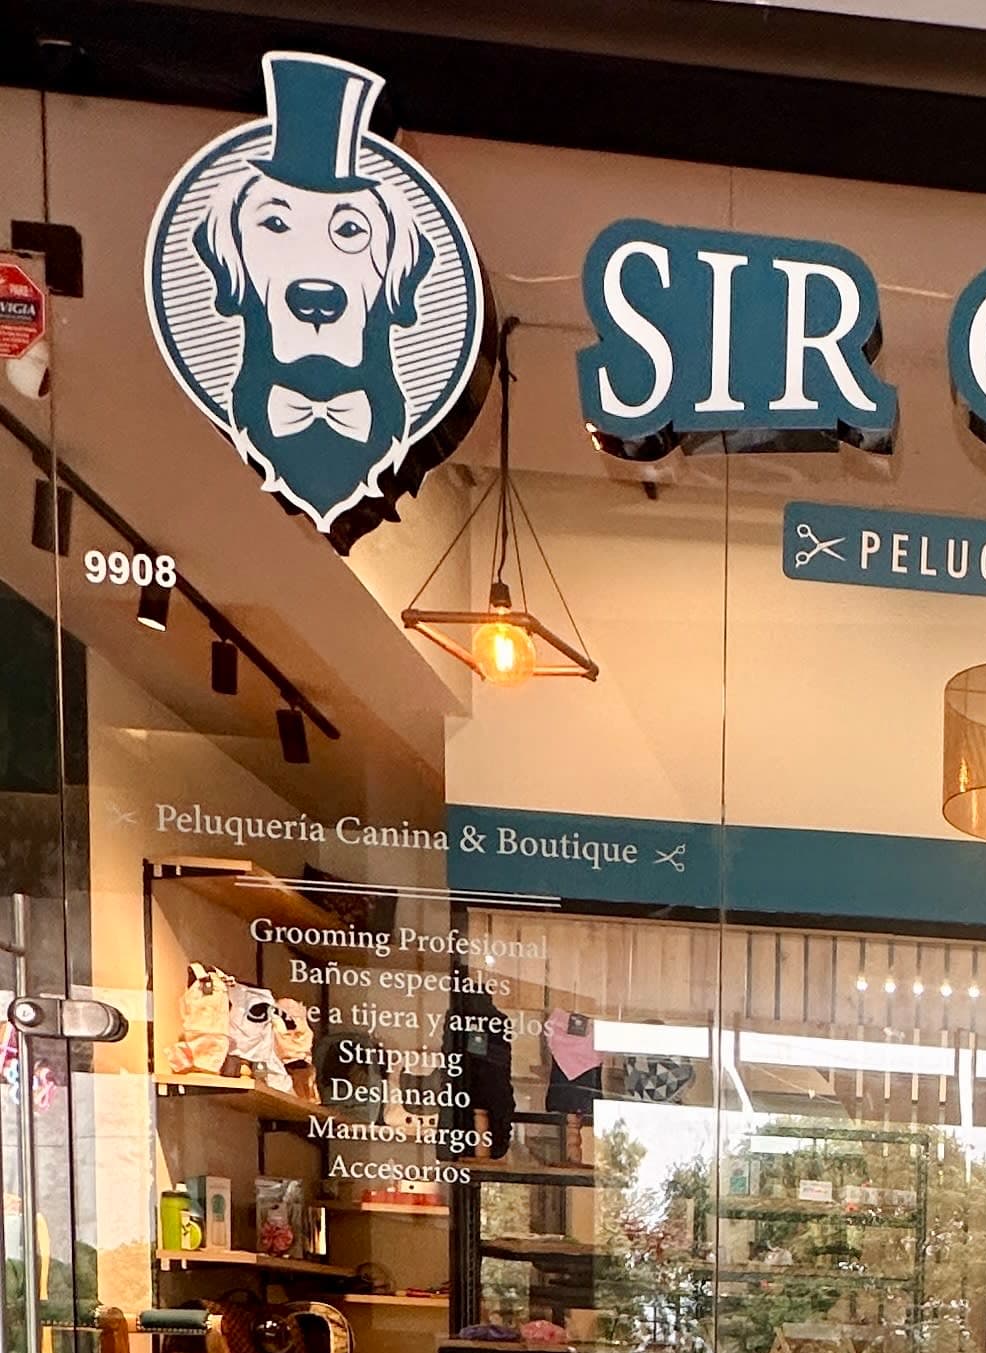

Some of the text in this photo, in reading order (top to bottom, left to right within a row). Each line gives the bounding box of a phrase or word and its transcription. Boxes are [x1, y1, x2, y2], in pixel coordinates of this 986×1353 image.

[598, 240, 878, 419] SIR
[84, 551, 177, 588] 9908
[155, 803, 639, 871] Peluquería Canina & Boutique
[250, 917, 549, 960] Grooming Profesional
[289, 959, 512, 997] Baños especiales
[328, 1007, 343, 1024] a
[351, 1004, 420, 1034] tijera
[427, 1012, 443, 1036] y
[449, 1010, 554, 1042] arreglos
[338, 1039, 464, 1077] Stripping
[330, 1077, 472, 1109] Deslanado
[305, 1114, 494, 1153] Mantos largos
[328, 1154, 472, 1185] Accesorios
